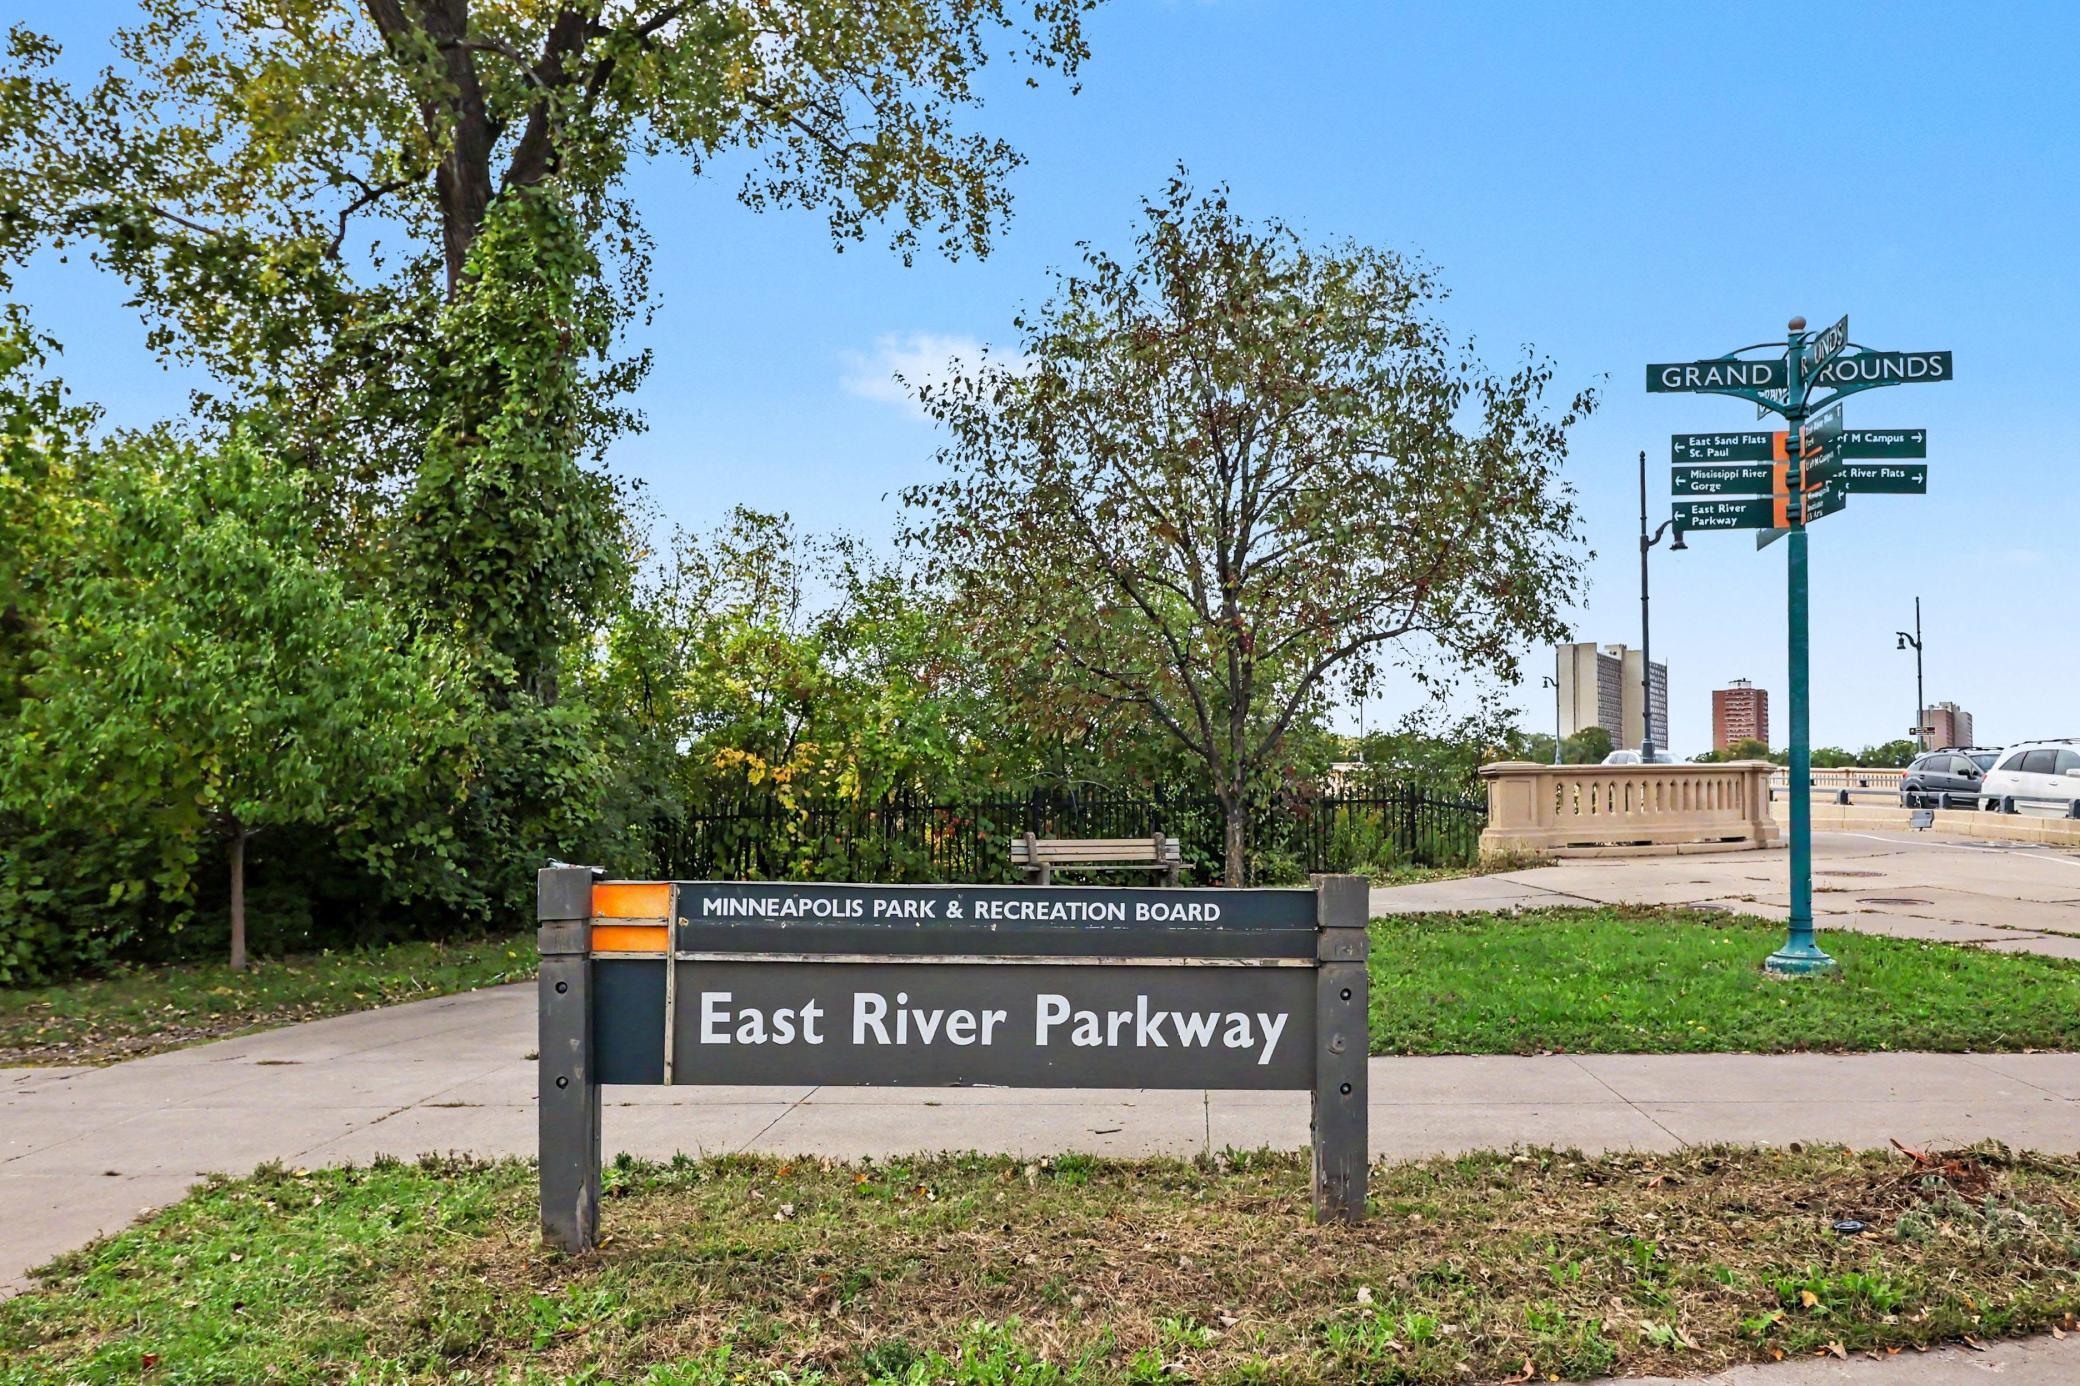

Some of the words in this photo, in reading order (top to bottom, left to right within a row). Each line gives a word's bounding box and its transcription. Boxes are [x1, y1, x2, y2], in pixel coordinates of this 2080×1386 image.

[1661, 364, 1772, 388] GRAND
[1689, 436, 1711, 447] East
[1714, 435, 1739, 445] Sand
[1742, 435, 1767, 445] Flats
[1851, 433, 1861, 443] M
[1864, 433, 1905, 446] Campus
[1689, 448, 1704, 458] St.
[1707, 448, 1729, 457] Paul
[1690, 469, 1740, 481] Mississippi
[1742, 468, 1767, 478] River
[1850, 468, 1878, 478] River
[1880, 468, 1906, 478] Flats
[1690, 481, 1722, 493] Gorge
[1691, 505, 1715, 515] East
[1718, 503, 1747, 513] River
[1692, 516, 1738, 527] Parkway
[702, 896, 864, 919] MINNEAPOLIS
[872, 898, 936, 920] PARK
[945, 900, 964, 920] &
[974, 900, 1126, 922] RECREATION
[1135, 902, 1221, 923] BOARD
[699, 991, 824, 1046] East
[852, 991, 1007, 1046] River
[1035, 993, 1289, 1066] Parkway
